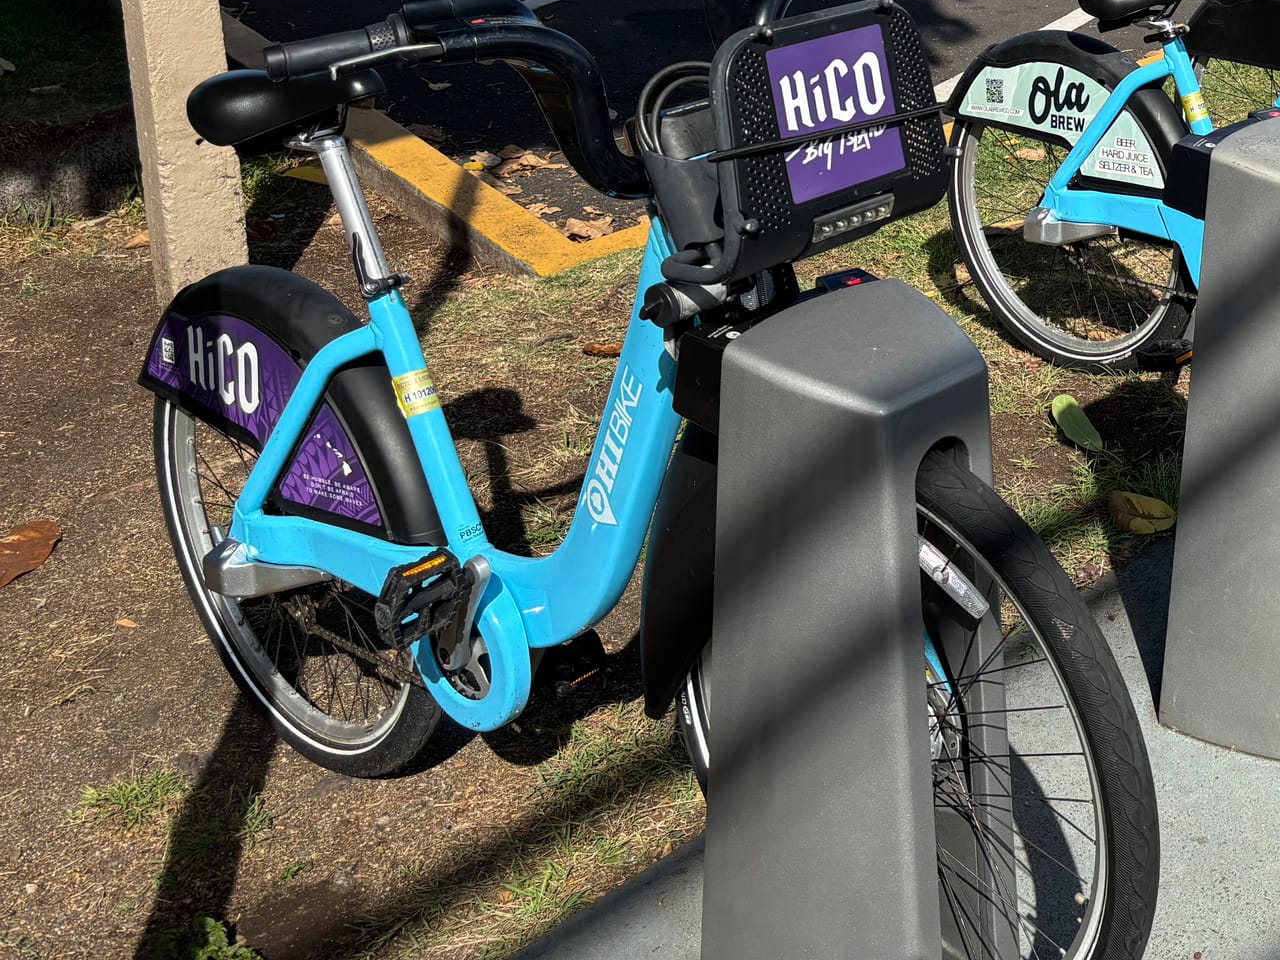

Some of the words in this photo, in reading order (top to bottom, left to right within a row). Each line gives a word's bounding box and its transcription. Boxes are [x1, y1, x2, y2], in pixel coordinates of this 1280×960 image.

[1028, 66, 1091, 125] Ola
[1050, 114, 1086, 133] BREW
[1116, 137, 1137, 149] BEER
[1101, 148, 1125, 160] HARD
[1126, 152, 1149, 163] JUICE
[1098, 160, 1131, 173] SELTZER
[1139, 166, 1154, 177] TEA
